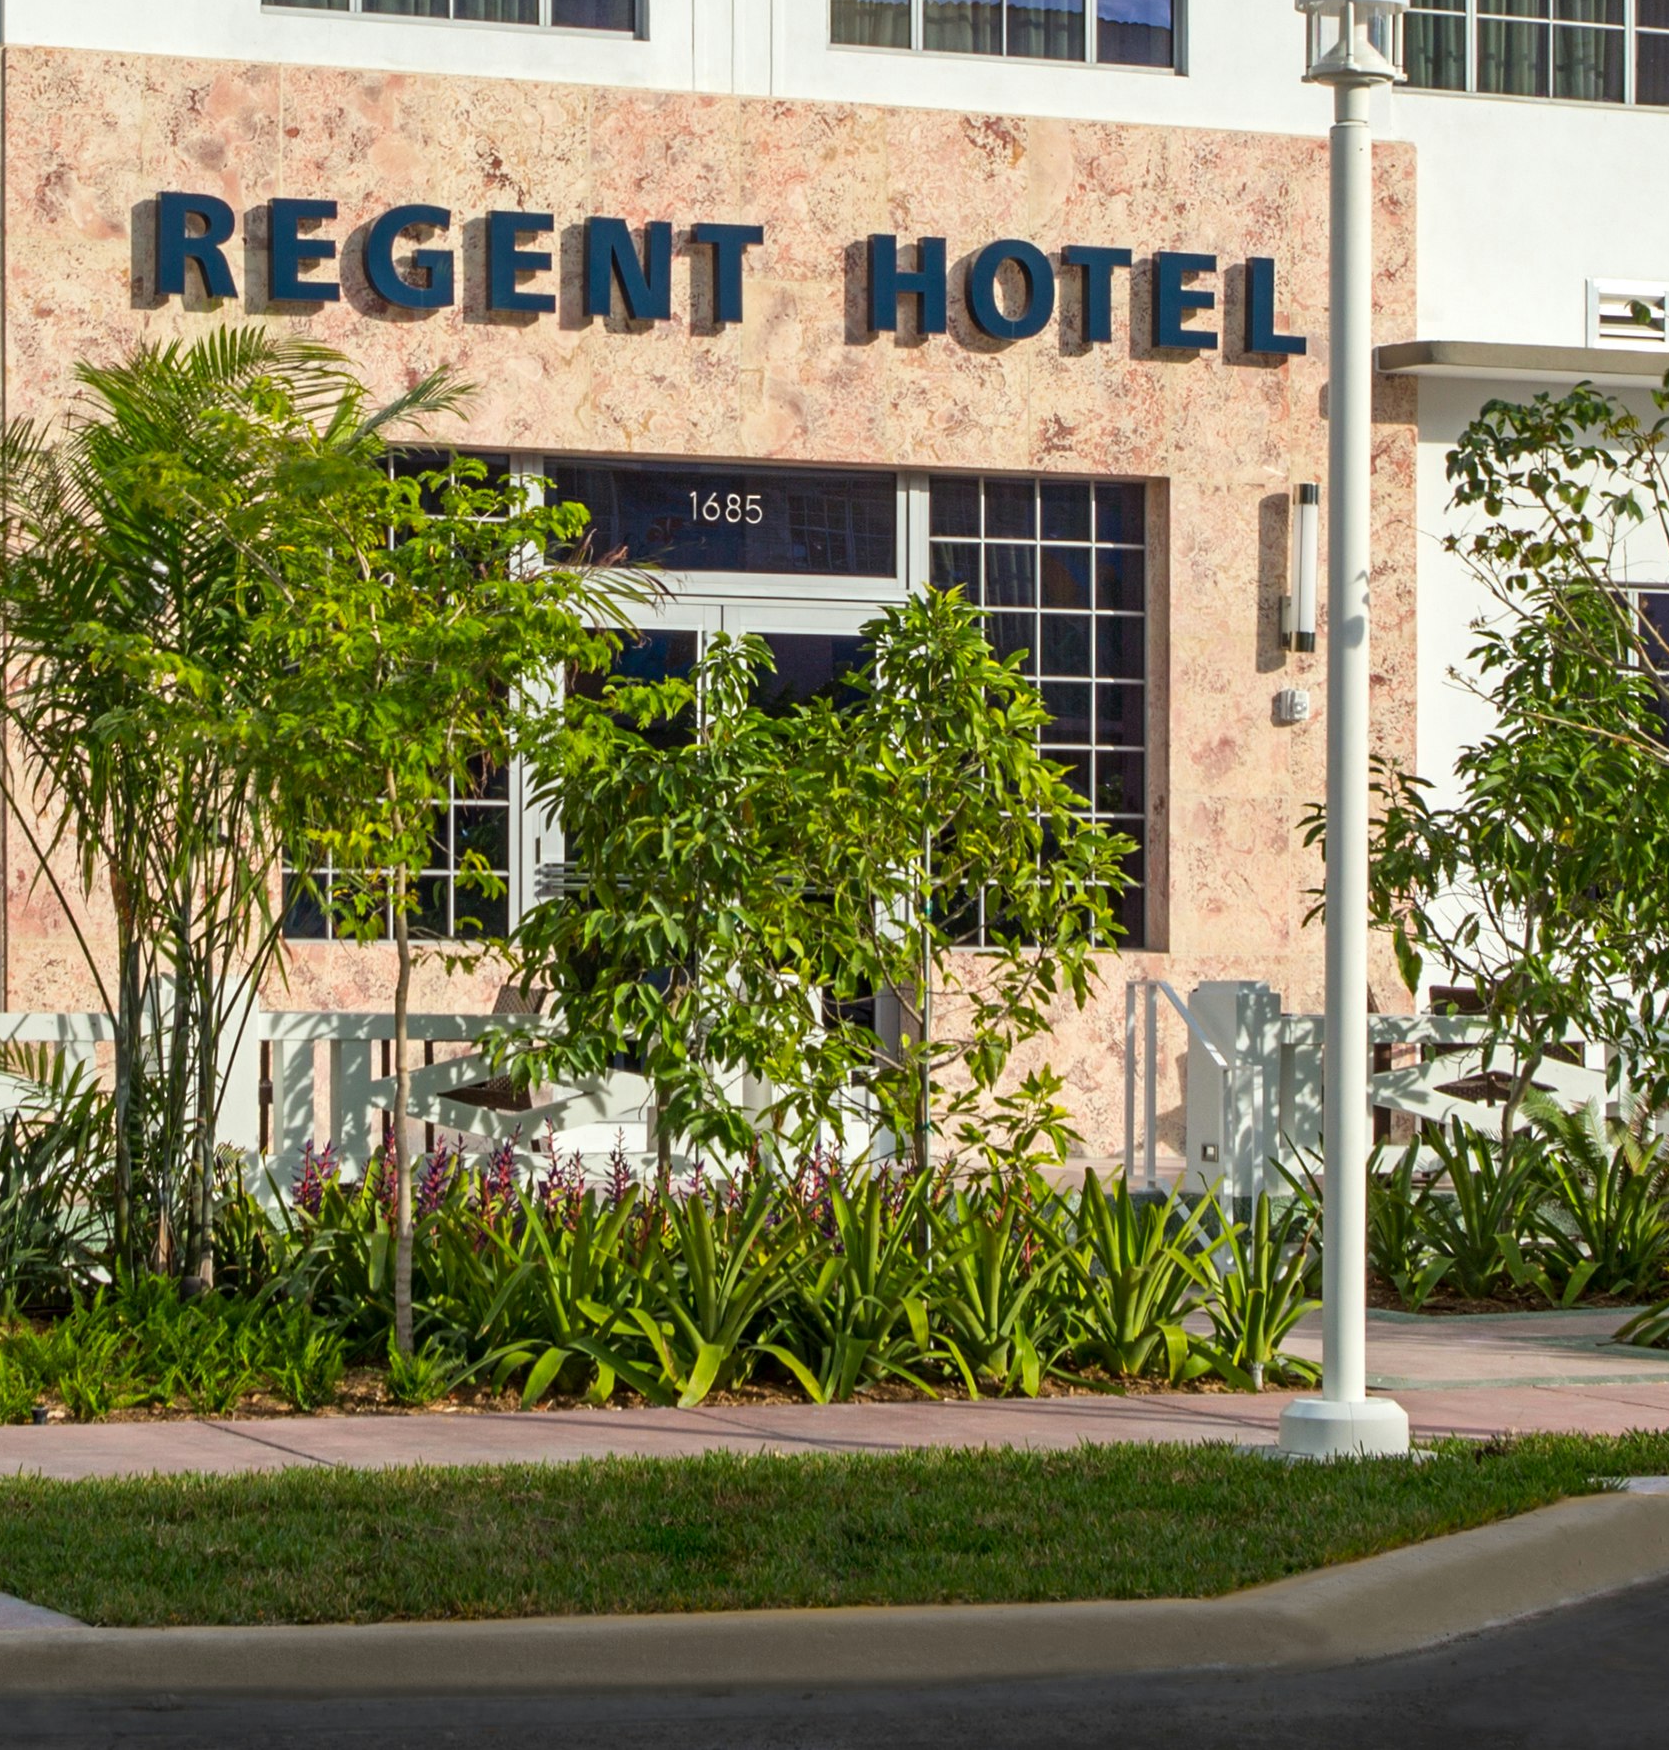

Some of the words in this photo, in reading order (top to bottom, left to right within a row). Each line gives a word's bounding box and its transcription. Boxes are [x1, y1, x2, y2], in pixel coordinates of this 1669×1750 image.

[155, 190, 765, 325] REGENT
[867, 233, 1307, 356] HOTEL
[689, 490, 763, 525] 1685
